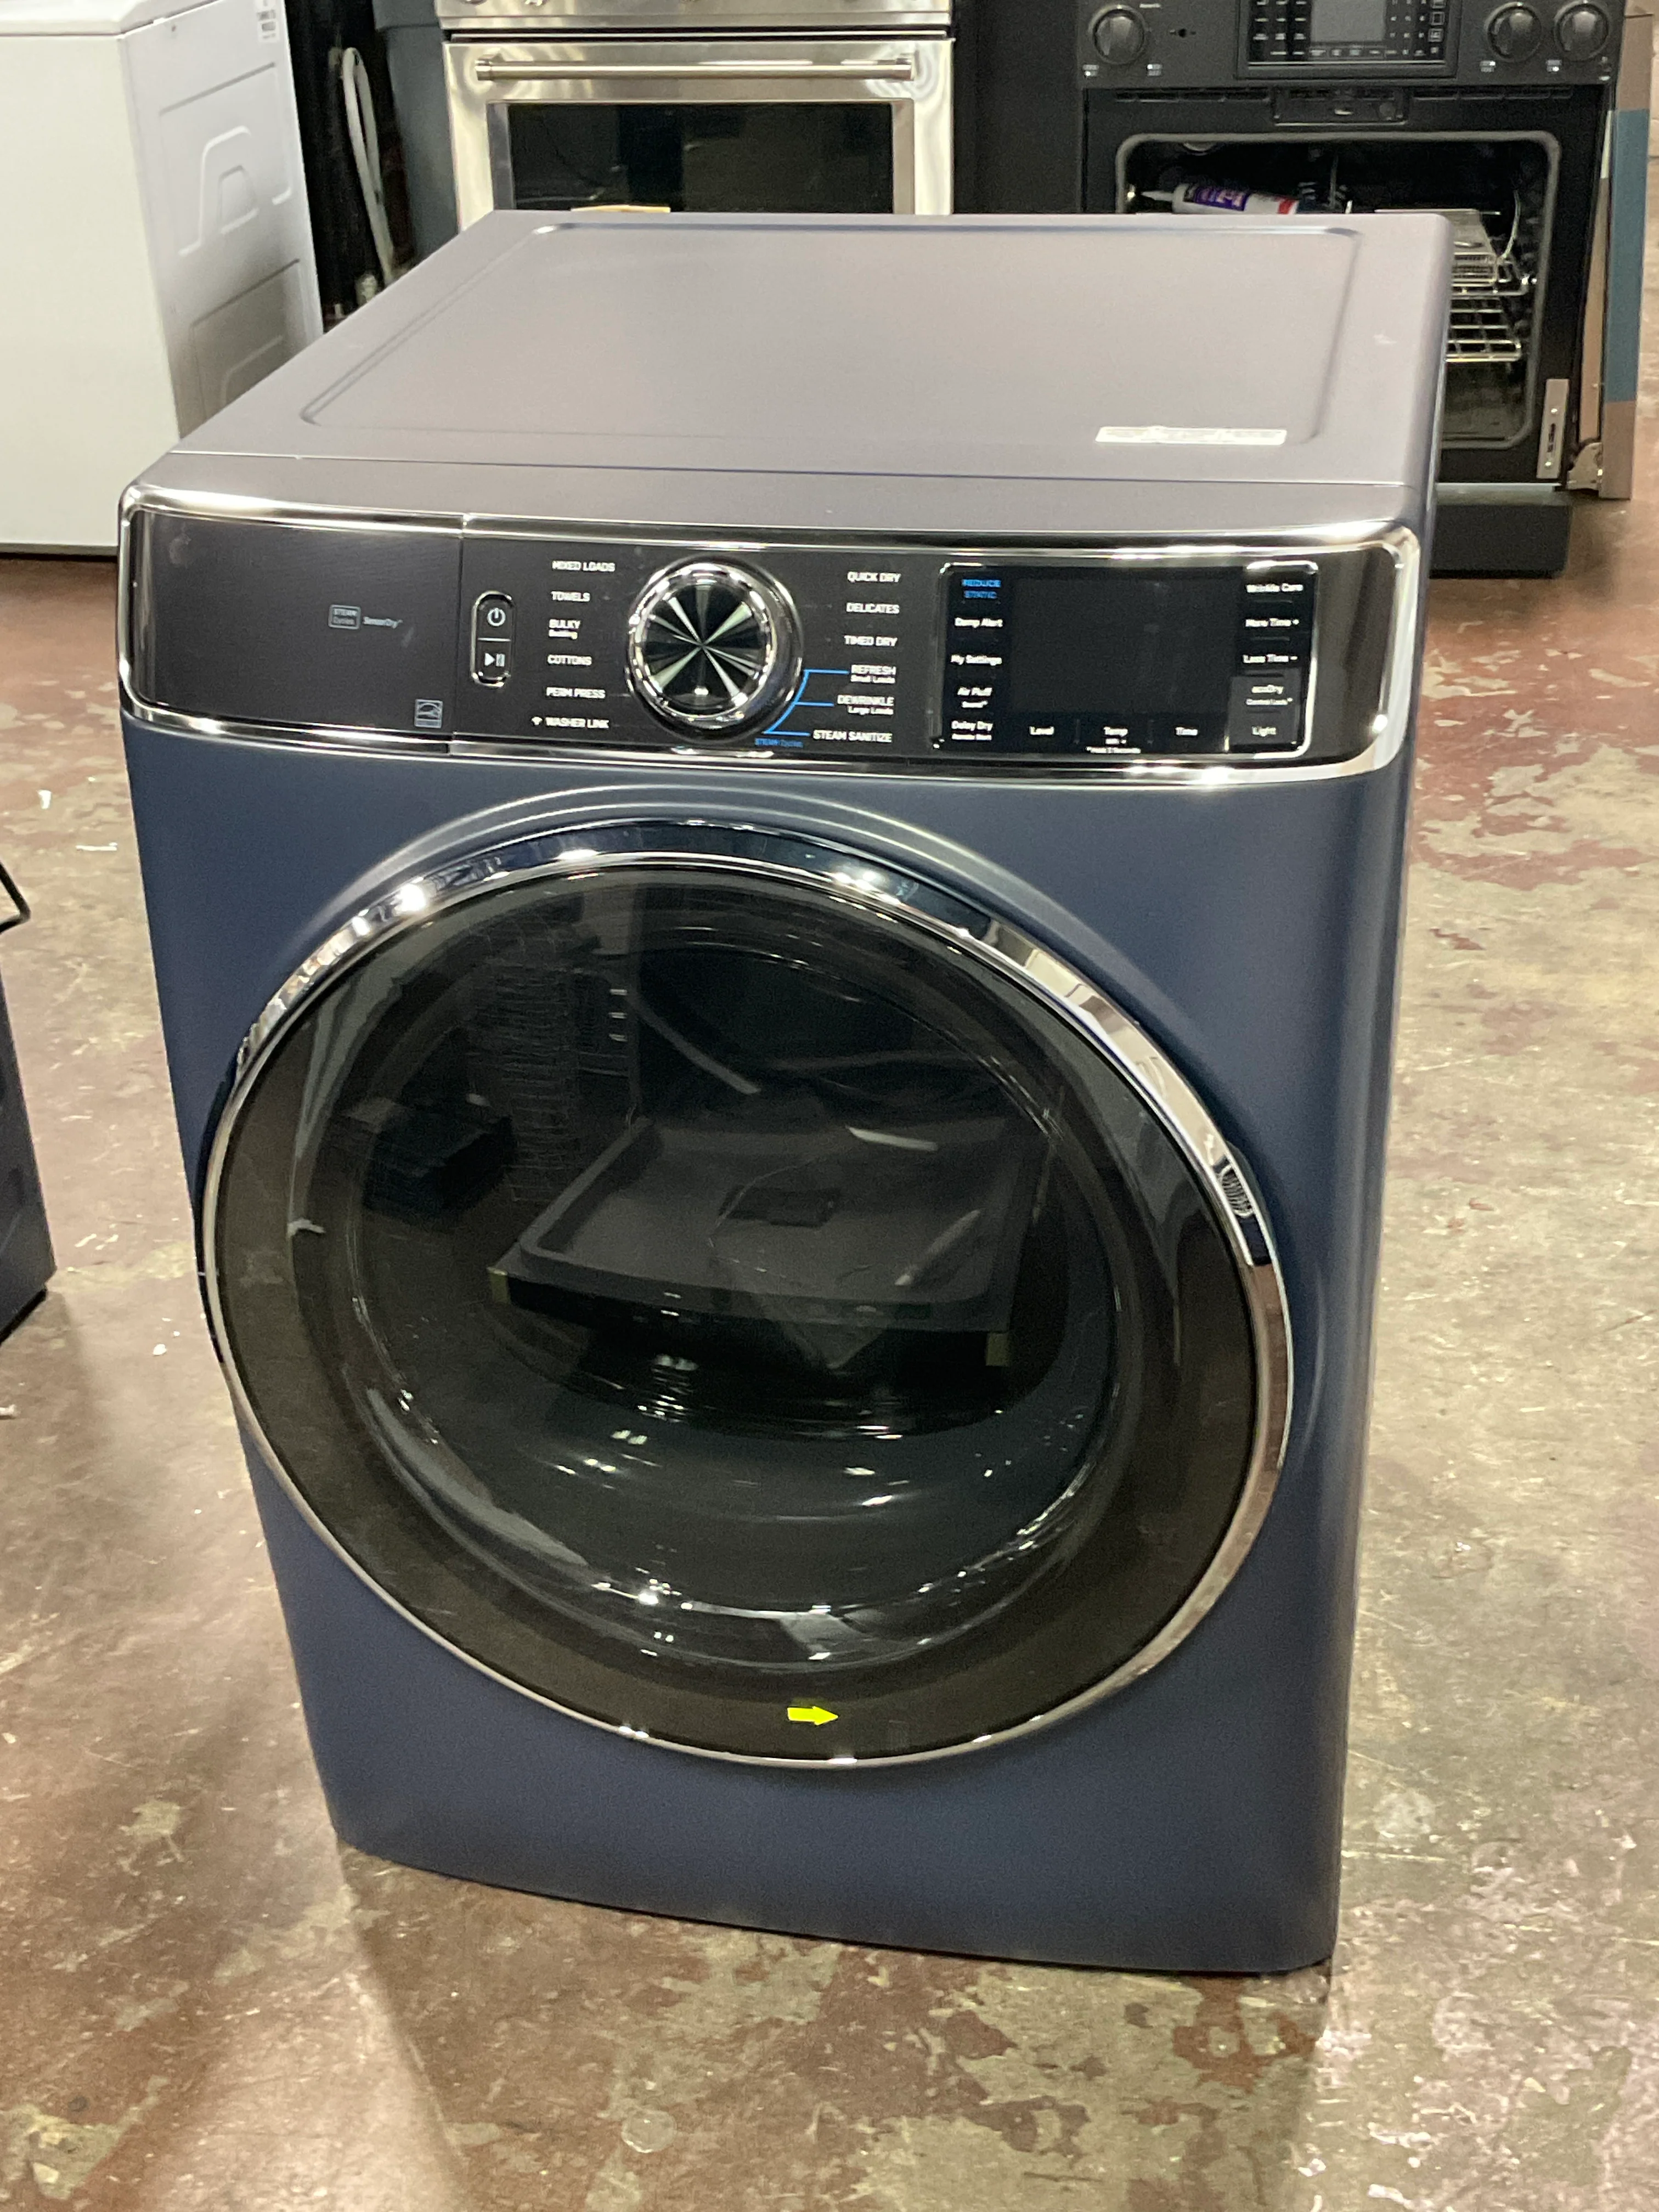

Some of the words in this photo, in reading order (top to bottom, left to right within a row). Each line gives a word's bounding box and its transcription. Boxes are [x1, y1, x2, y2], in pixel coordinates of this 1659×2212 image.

[552, 560, 582, 571] MIXED
[582, 561, 616, 572] LOADS
[848, 571, 878, 583] QUICK
[879, 572, 901, 583] DRY
[1281, 583, 1304, 592] Care
[551, 591, 590, 602] TOWELS
[847, 602, 900, 614] DELICATES
[549, 619, 581, 629] BULKY
[955, 617, 980, 628] Damp
[981, 618, 1003, 628] Alert
[1245, 618, 1269, 627] More
[1269, 618, 1291, 627] Time
[844, 635, 874, 646] TIMED
[876, 636, 898, 646] DRY
[547, 654, 592, 665] COTTONS
[951, 654, 964, 665] My
[966, 654, 1002, 666] Settings
[1243, 654, 1266, 663] Less
[1266, 653, 1289, 663] Time
[851, 664, 896, 675] REFRESH
[546, 687, 573, 697] PERM
[574, 688, 606, 699] PRESS
[837, 695, 894, 706] DEWRINKLE
[545, 716, 586, 728] WASHER
[586, 718, 609, 729] LINK
[951, 720, 977, 731] Delay
[977, 721, 994, 731] Dry
[813, 729, 847, 740] STEAM
[848, 731, 893, 743] SANITIZE
[1029, 726, 1055, 736] Level
[1103, 726, 1128, 737] Temp
[1176, 726, 1198, 736] Time
[1251, 726, 1277, 737] Light
